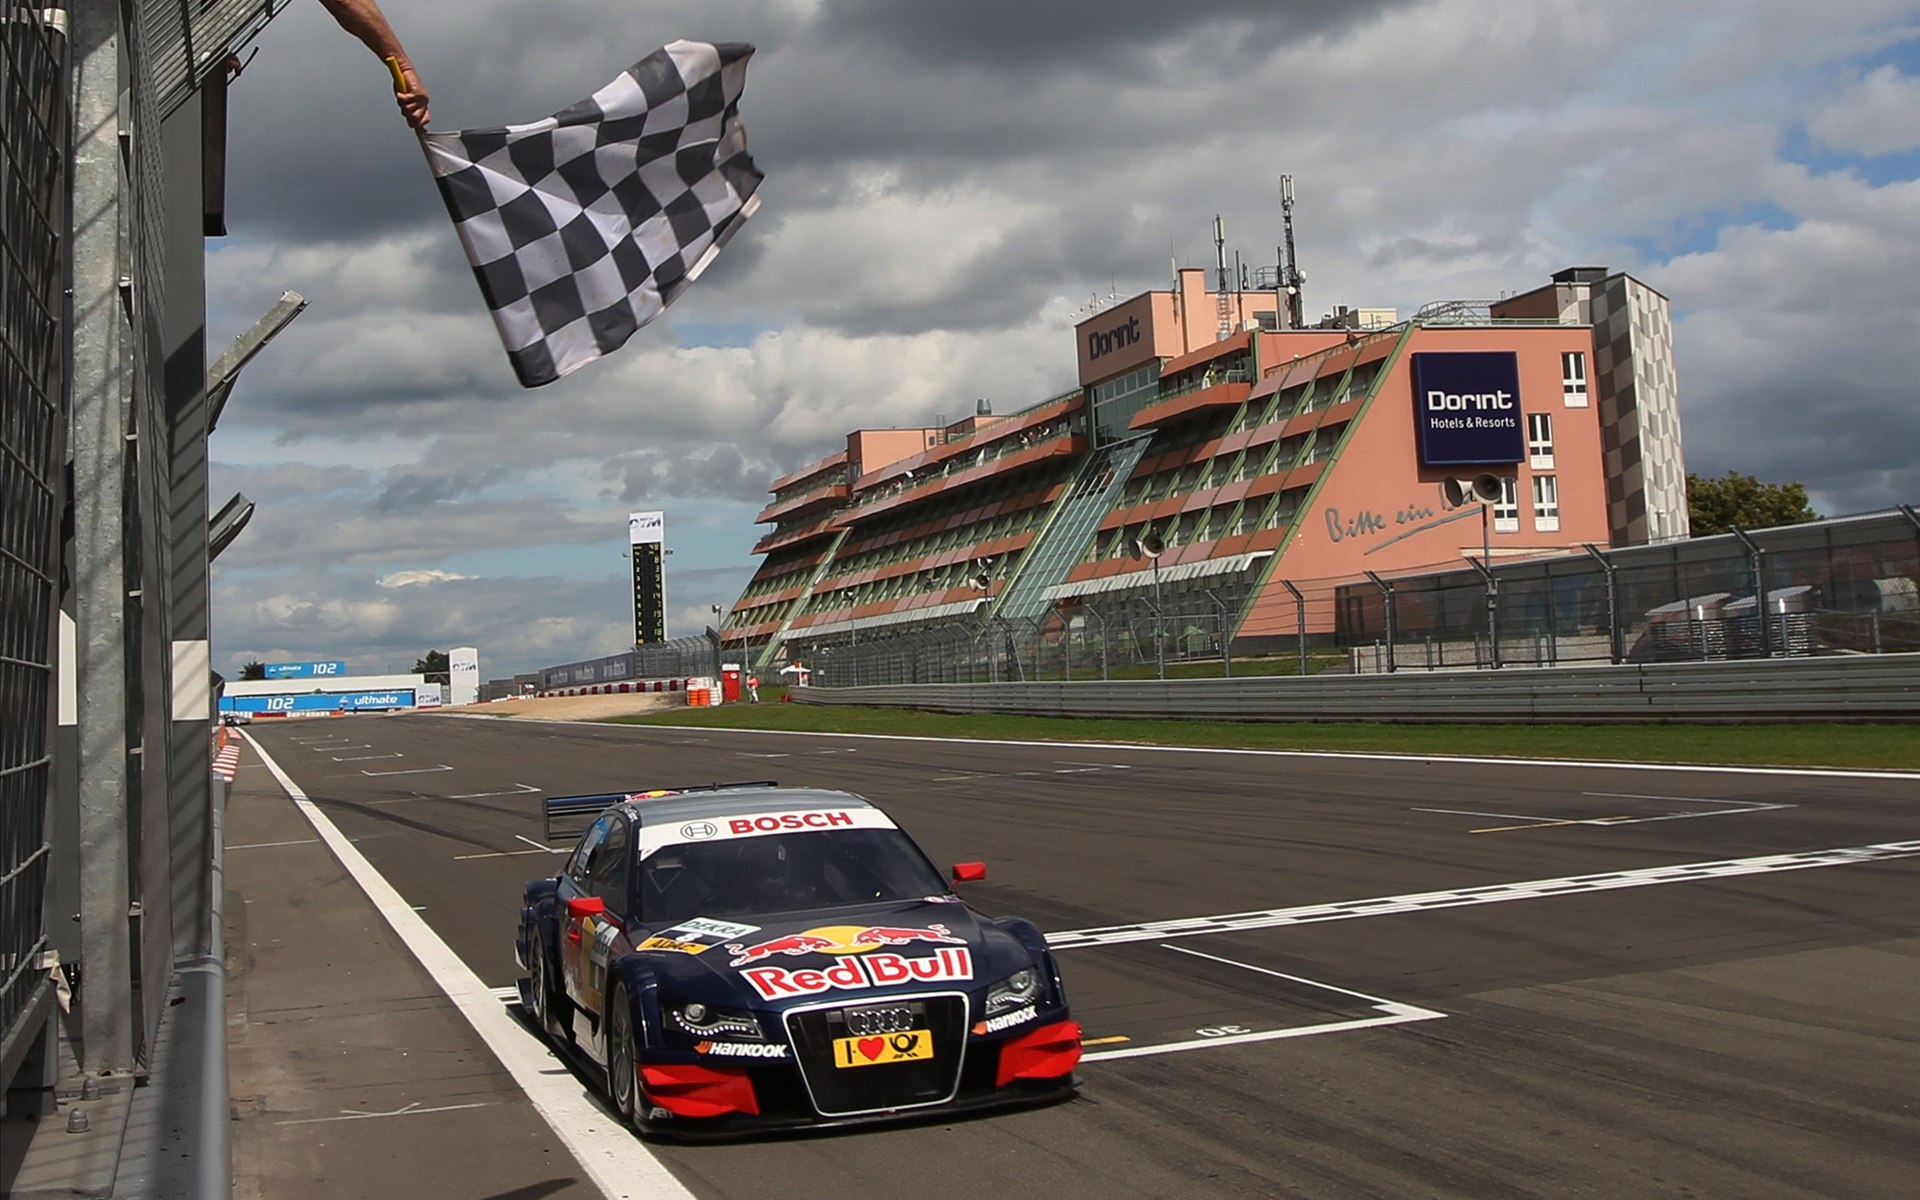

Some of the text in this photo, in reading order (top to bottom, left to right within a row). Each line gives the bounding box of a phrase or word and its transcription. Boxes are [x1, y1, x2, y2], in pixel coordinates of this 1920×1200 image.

[1089, 316, 1140, 361] Dorint
[1427, 389, 1514, 411] Dorint
[1430, 417, 1516, 429] Hotels & Resorts
[1325, 504, 1434, 543] Bitte ein
[312, 663, 337, 674] 102
[267, 694, 398, 710] 102 ultimate
[728, 812, 854, 835] BOSCH
[681, 921, 746, 936] DEKRA
[646, 938, 697, 951] ADAC
[745, 949, 971, 997] Red Bull
